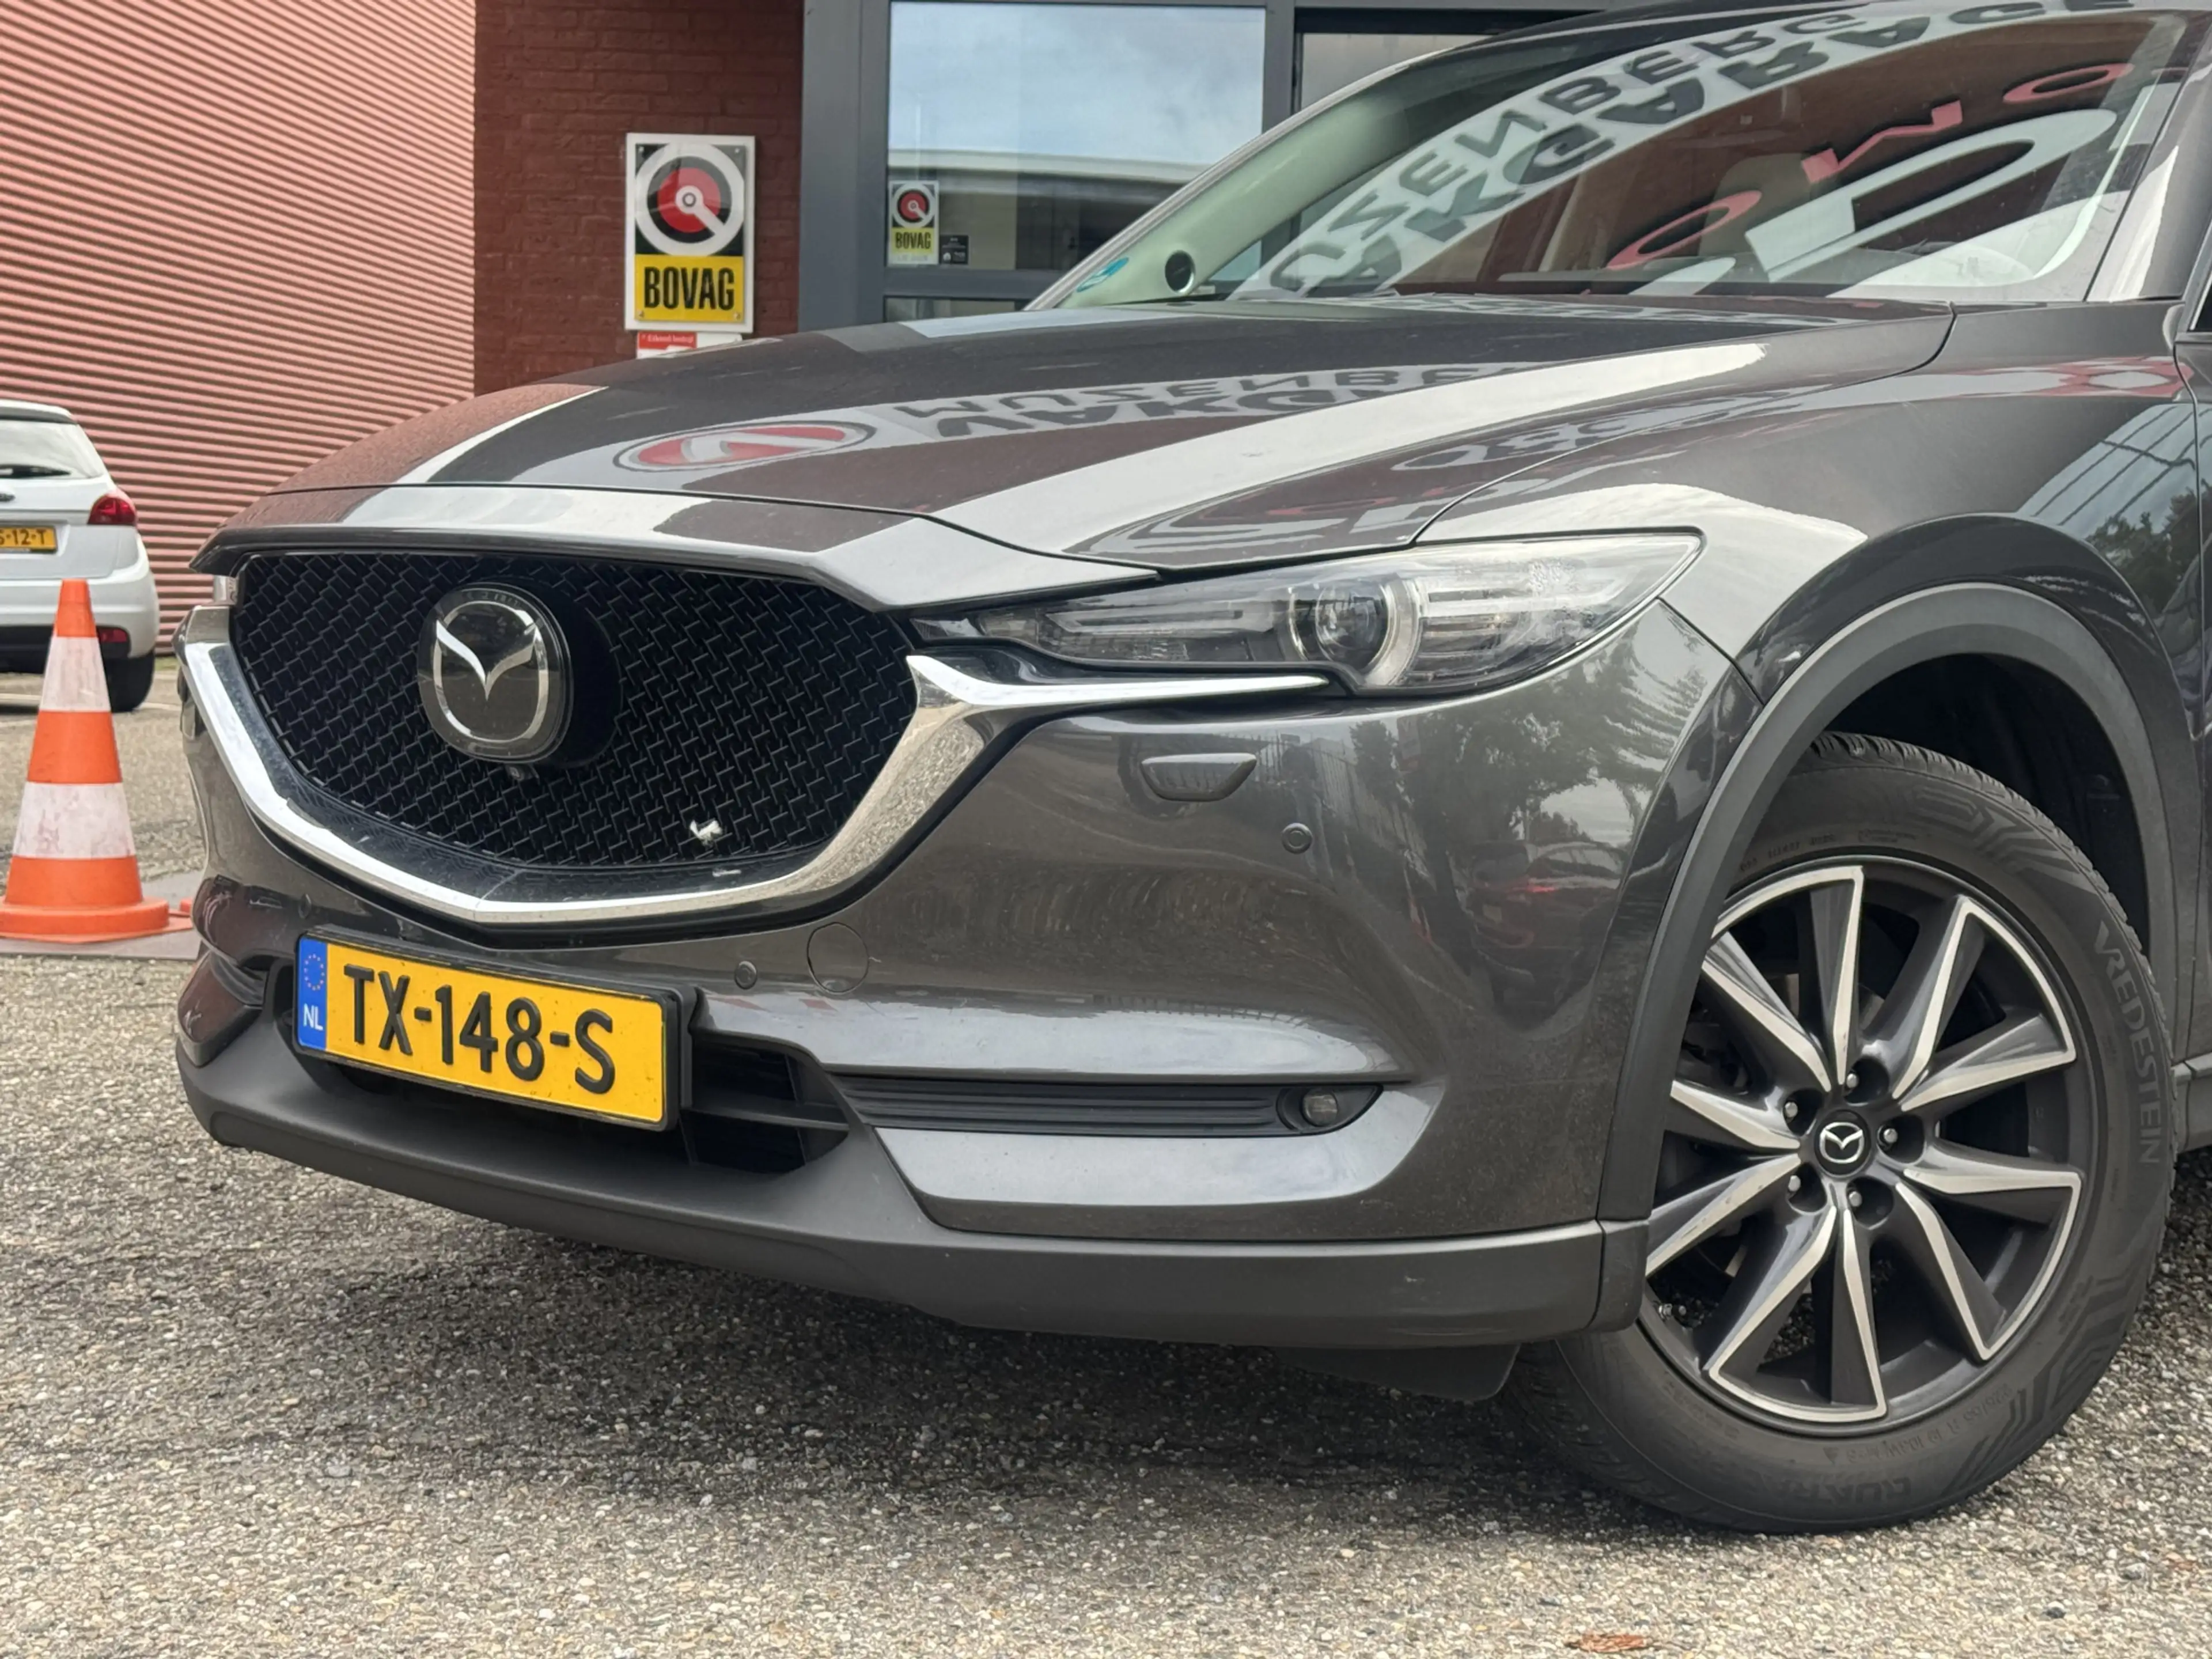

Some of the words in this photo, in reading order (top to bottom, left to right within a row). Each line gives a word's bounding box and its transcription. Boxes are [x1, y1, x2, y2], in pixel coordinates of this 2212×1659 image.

[895, 232, 931, 249] BOVAG
[644, 267, 734, 310] BOVAG
[303, 1003, 323, 1031] NL
[344, 963, 616, 1095] TX-148-S
[2093, 920, 2162, 1165] VREDESTEIN
